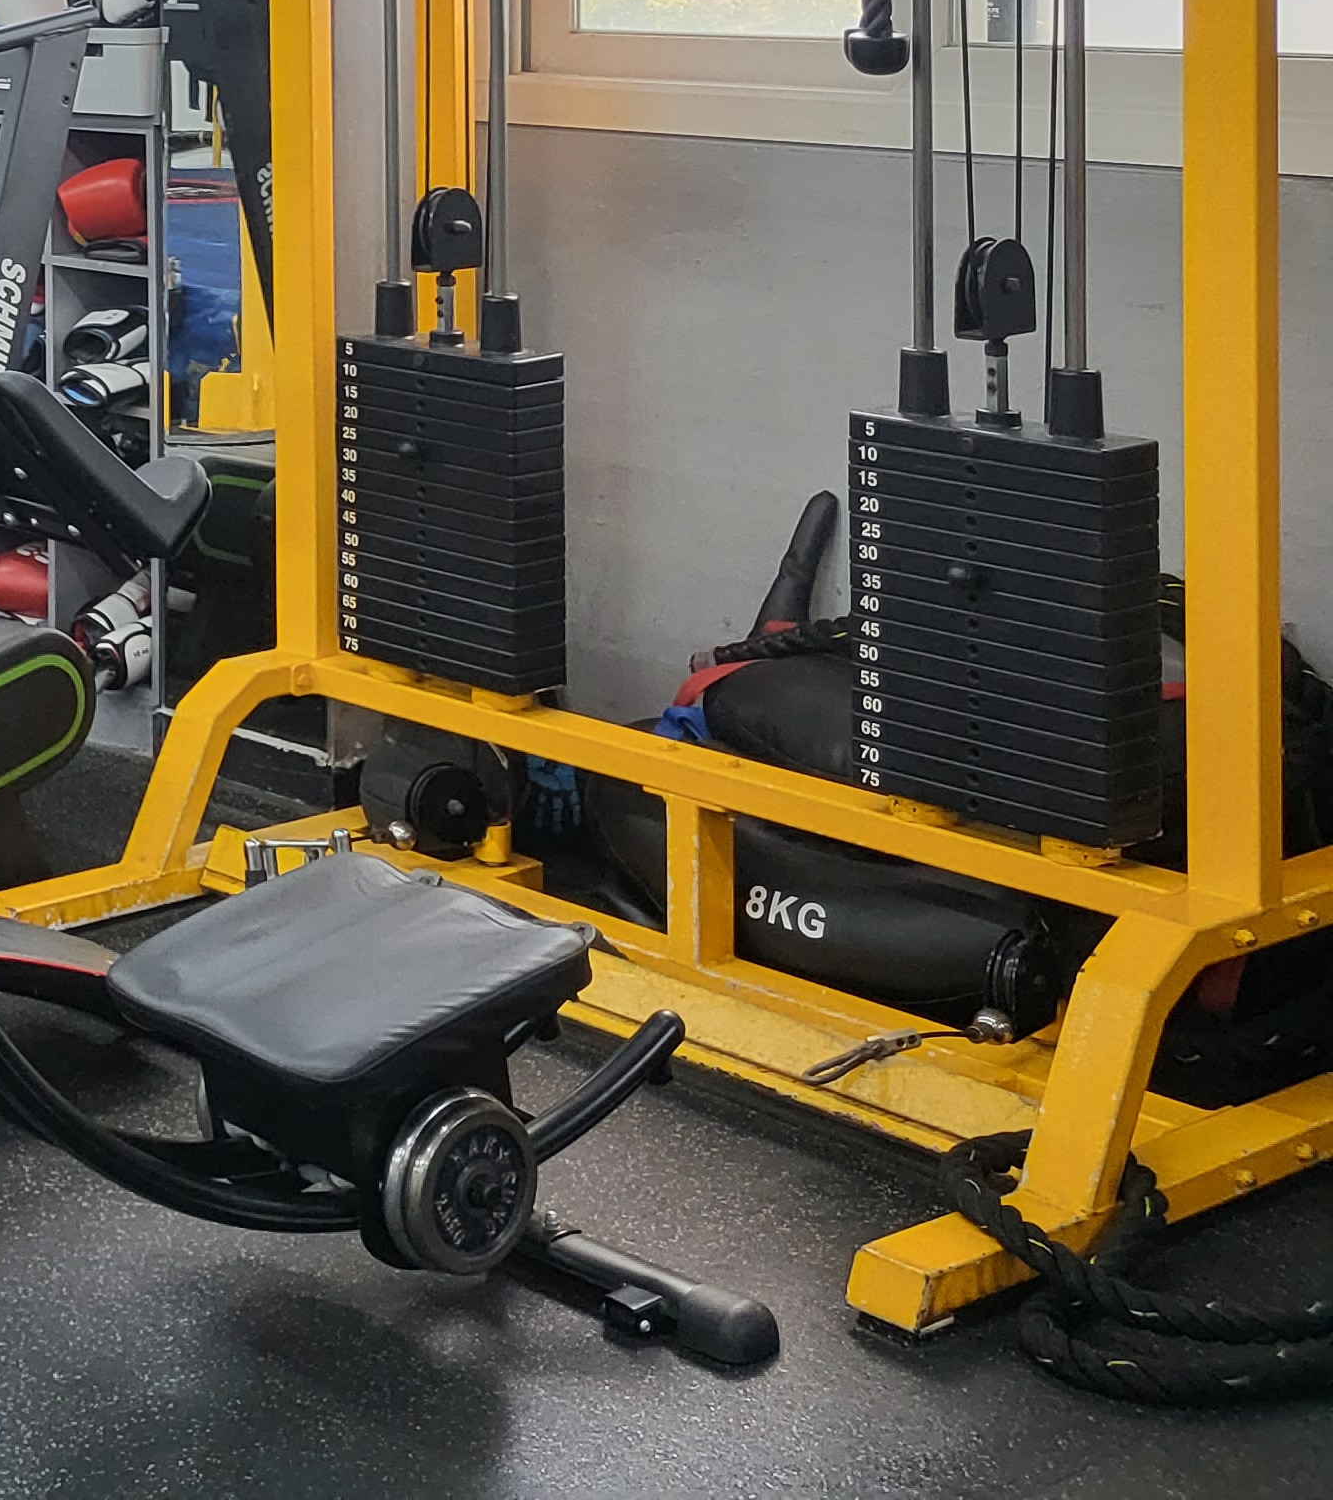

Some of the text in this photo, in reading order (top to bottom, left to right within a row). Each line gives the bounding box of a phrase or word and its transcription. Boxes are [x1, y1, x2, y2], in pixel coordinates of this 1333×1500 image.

[345, 342, 354, 356] 5
[342, 363, 358, 377] 10
[344, 385, 358, 399] 15
[343, 405, 358, 419] 20
[342, 426, 357, 440] 25
[865, 421, 875, 437] 5
[342, 447, 358, 462] 30
[857, 445, 878, 462] 10
[341, 467, 356, 483] 35
[858, 470, 878, 487] 15
[340, 488, 356, 503] 40
[859, 496, 880, 513] 20
[342, 510, 357, 525] 45
[861, 521, 881, 539] 25
[344, 532, 359, 547] 50
[341, 551, 356, 567] 55
[858, 544, 878, 561] 30
[343, 573, 359, 589] 60
[861, 572, 882, 590] 35
[342, 594, 357, 609] 65
[859, 595, 880, 612] 40
[342, 614, 357, 630] 70
[860, 620, 880, 638] 45
[344, 635, 359, 652] 75
[858, 643, 879, 662] 50
[860, 669, 880, 687] 55
[862, 695, 883, 713] 60
[860, 720, 881, 738] 65
[859, 744, 880, 763] 70
[860, 768, 880, 787] 75
[745, 885, 827, 939] 8KG
